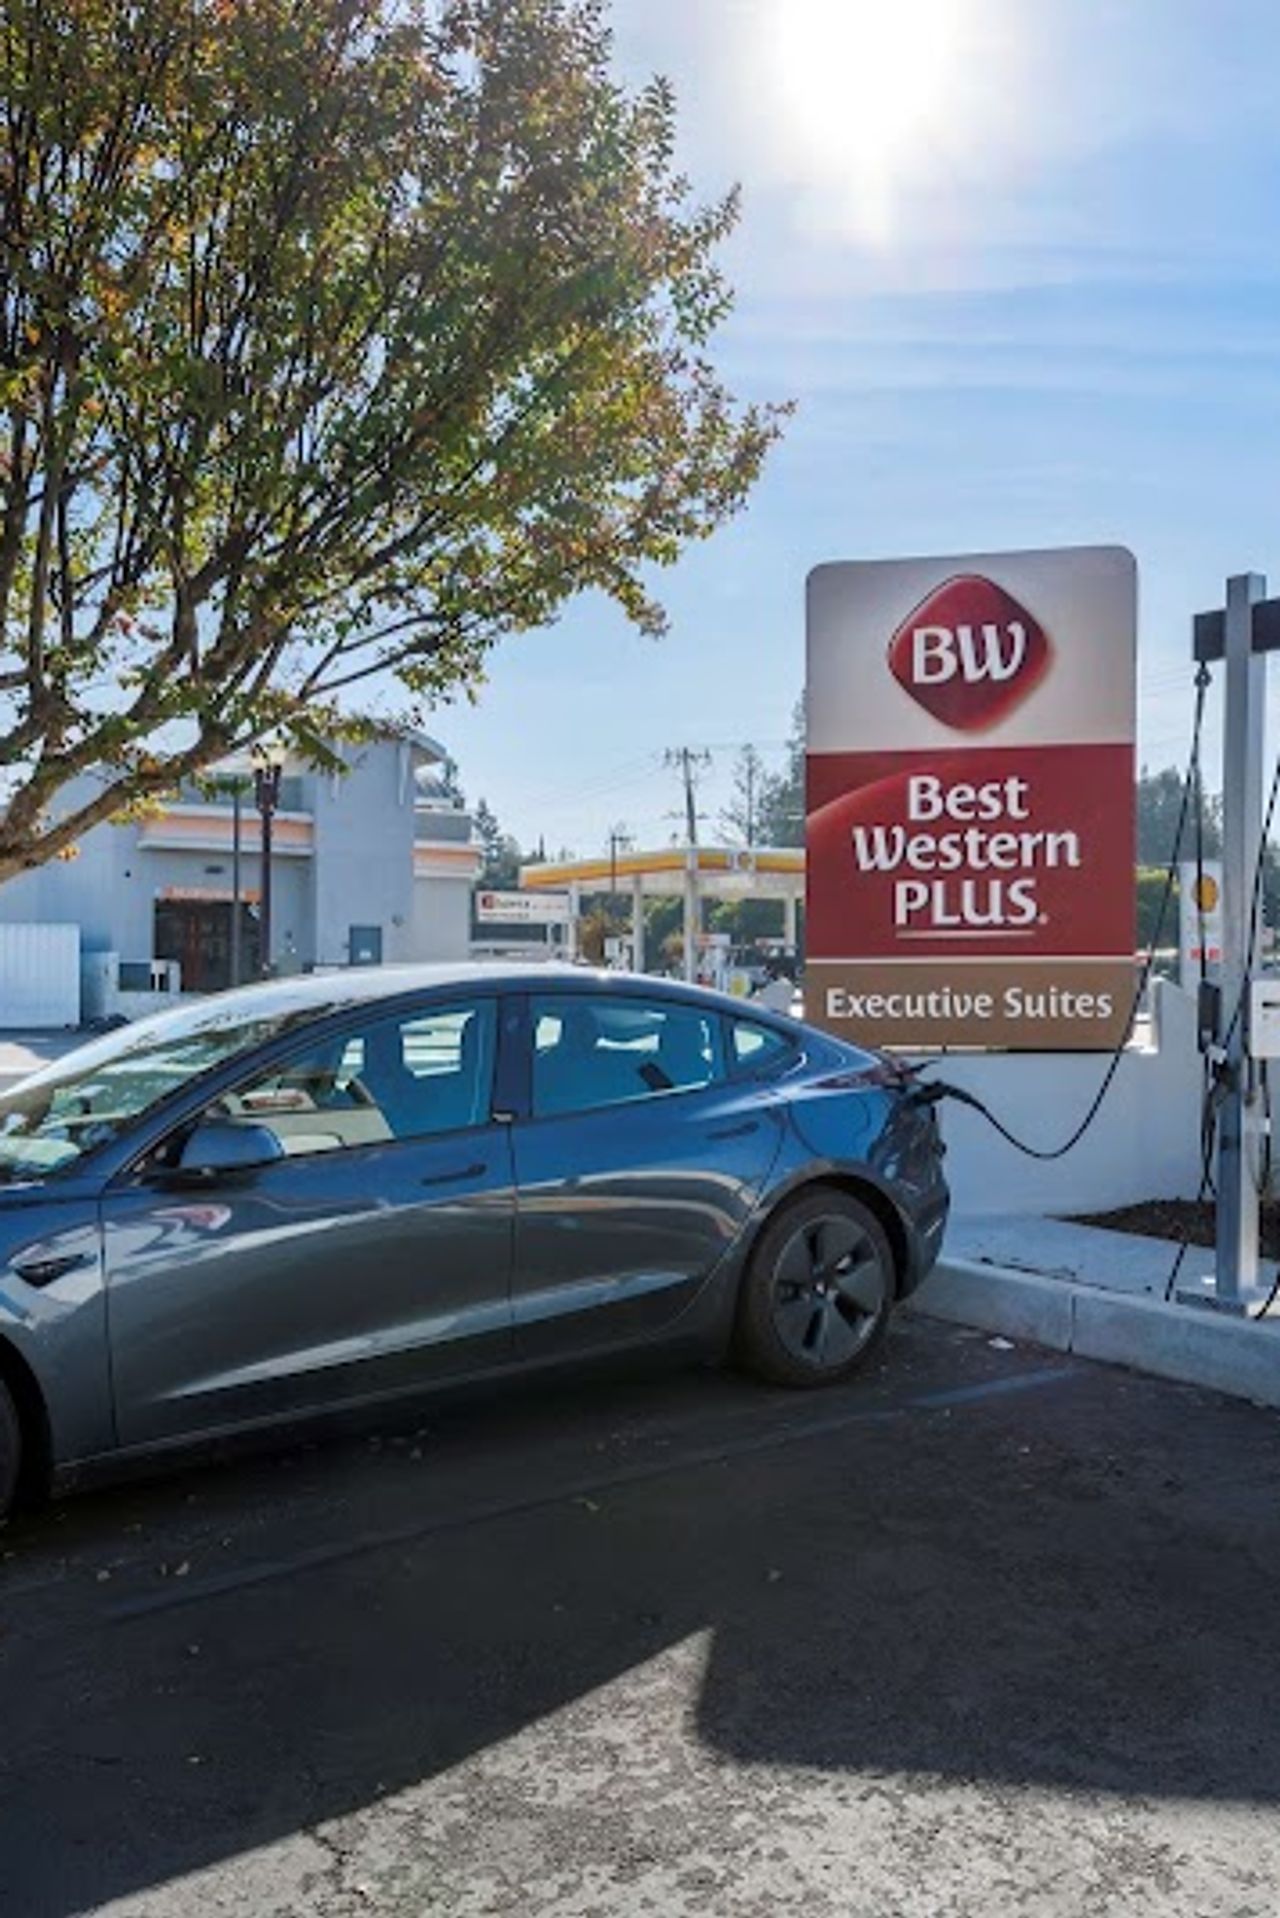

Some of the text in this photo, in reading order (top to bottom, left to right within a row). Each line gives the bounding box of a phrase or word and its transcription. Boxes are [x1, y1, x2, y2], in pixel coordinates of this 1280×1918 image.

[912, 622, 1026, 684] BW
[908, 775, 1029, 821] Best
[853, 825, 1081, 871] Western
[826, 986, 1113, 1018] Executive Suites
